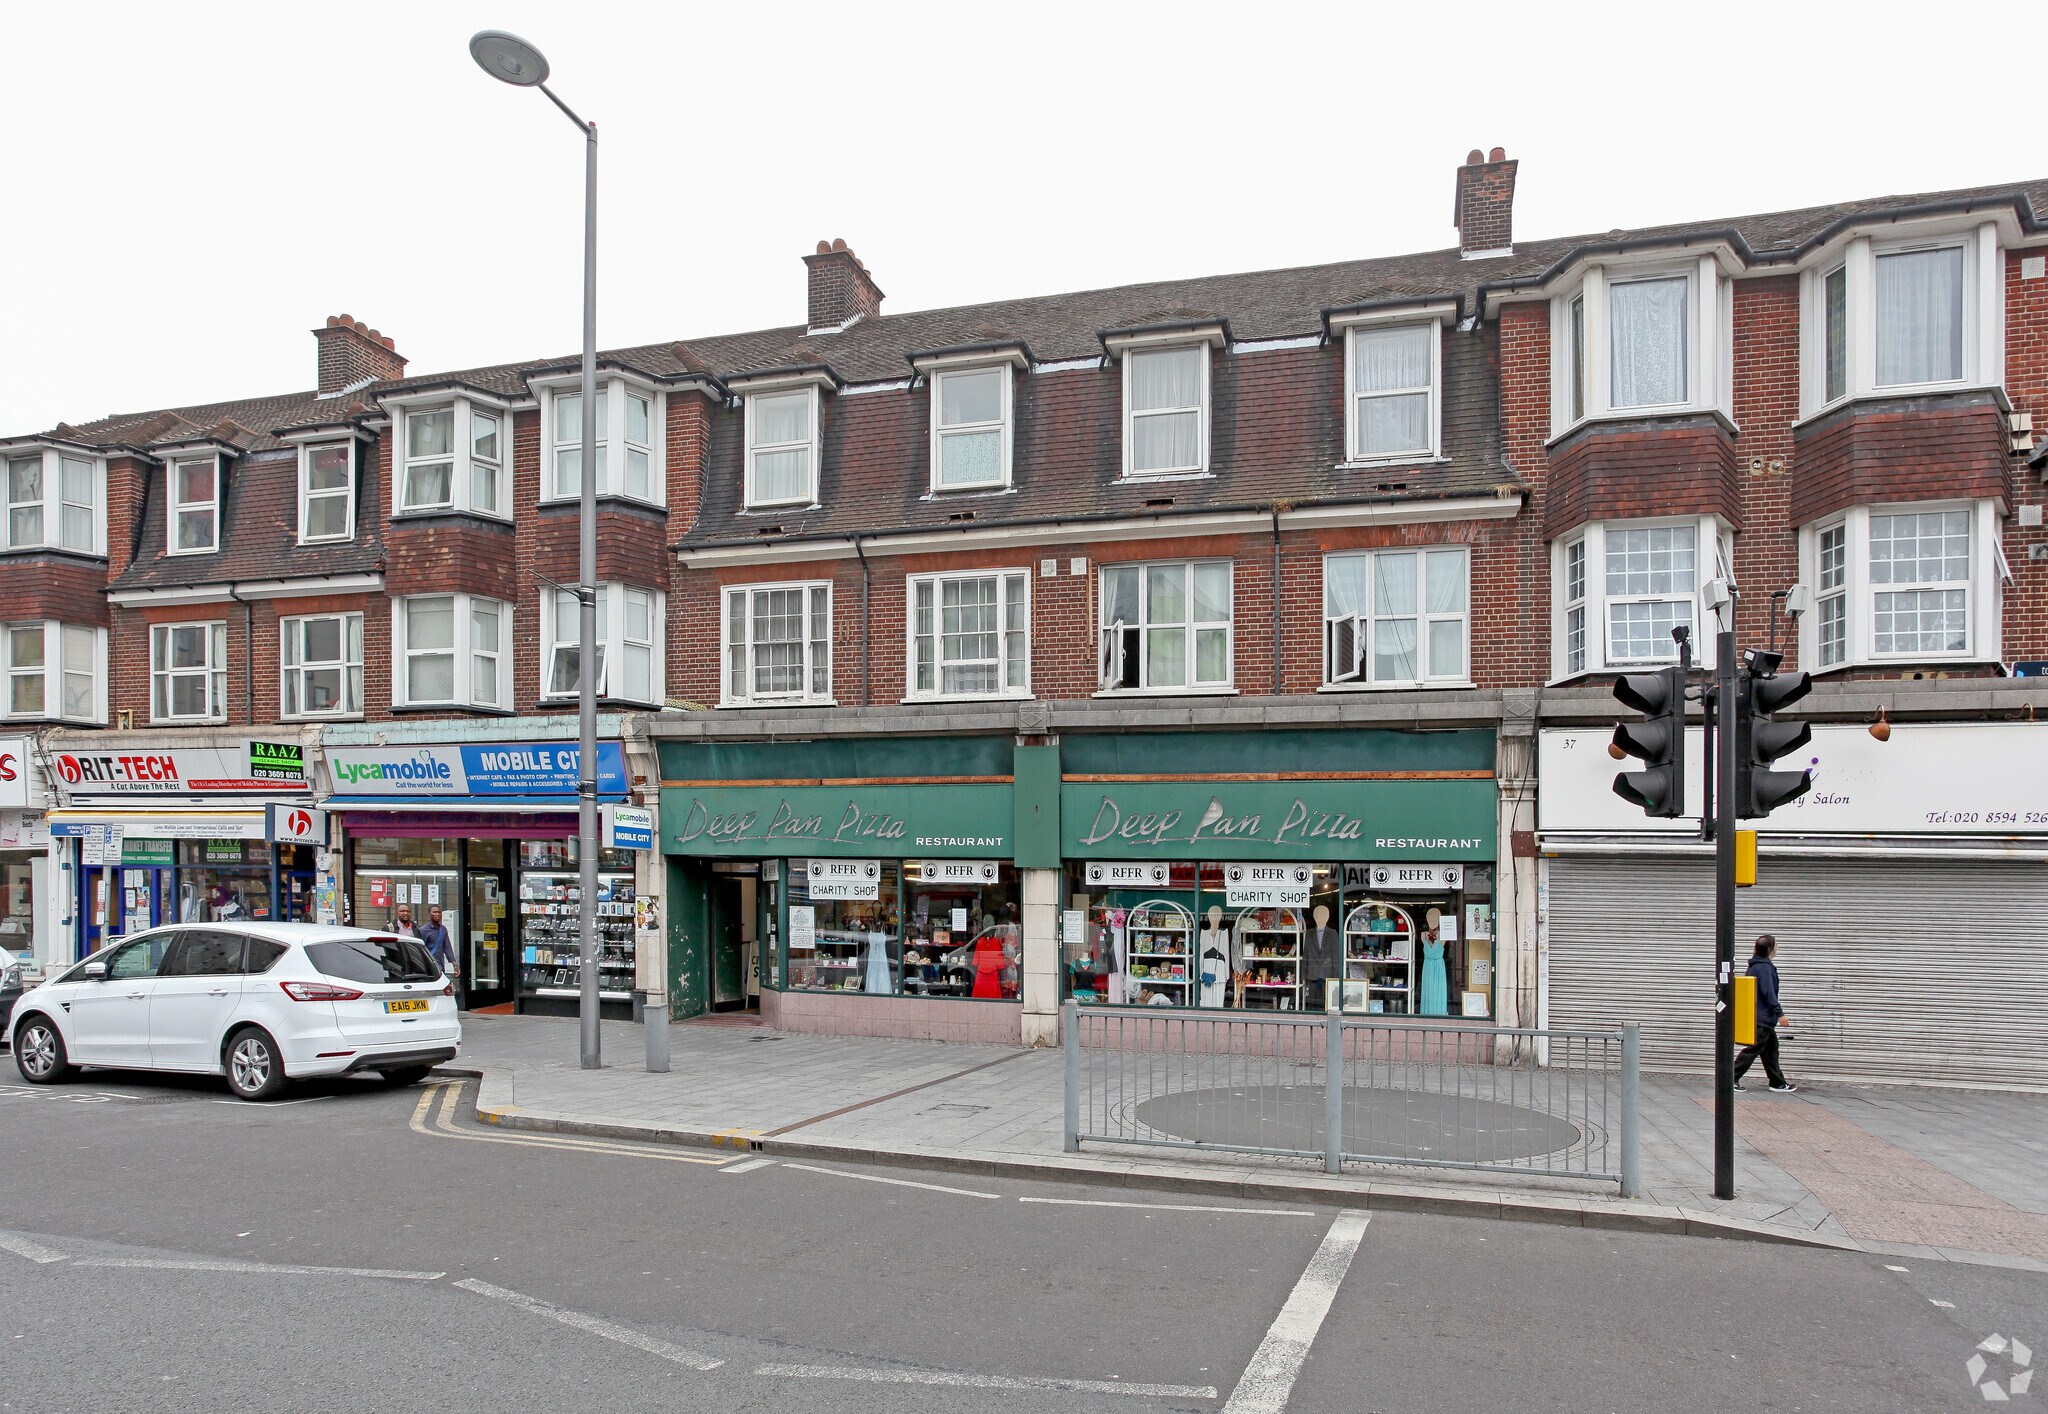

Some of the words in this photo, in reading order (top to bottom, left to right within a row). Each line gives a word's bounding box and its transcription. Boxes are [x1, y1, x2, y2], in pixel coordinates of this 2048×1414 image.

[1563, 739, 1576, 749] 37
[255, 743, 298, 758] RAAZ
[480, 751, 552, 770] MOBILE
[268, 770, 284, 778] 3609
[334, 758, 451, 784] Lycamobile
[1813, 792, 1850, 804] Salon
[22, 812, 38, 821] Storage
[616, 811, 650, 823] Lycamobile
[674, 798, 758, 842] Deep
[765, 799, 822, 842] Pan
[832, 800, 907, 842] Pizza
[1078, 795, 1182, 845] Deep
[1190, 796, 1262, 844] Pan
[1274, 796, 1363, 844] Pizza
[1986, 812, 2017, 823] 8594
[616, 832, 636, 842] MOBILE
[638, 834, 650, 842] CITY
[916, 837, 1003, 846] RESTAURANT
[124, 840, 142, 852] MONEY
[144, 840, 172, 852] TRANSFER
[1375, 838, 1482, 848] RESTAURANT
[830, 864, 857, 874] RFFR
[945, 866, 973, 875] RFFR
[1112, 868, 1142, 878] RFFR
[1252, 868, 1284, 879] RFFR
[1398, 870, 1433, 881] RFFR
[812, 886, 848, 895] CHARITY
[854, 886, 876, 896] SHOP
[1230, 892, 1272, 902] CHARITY
[1280, 893, 1308, 903] SHOP
[391, 1002, 410, 1011] EA16
[413, 1001, 426, 1010] JKN
